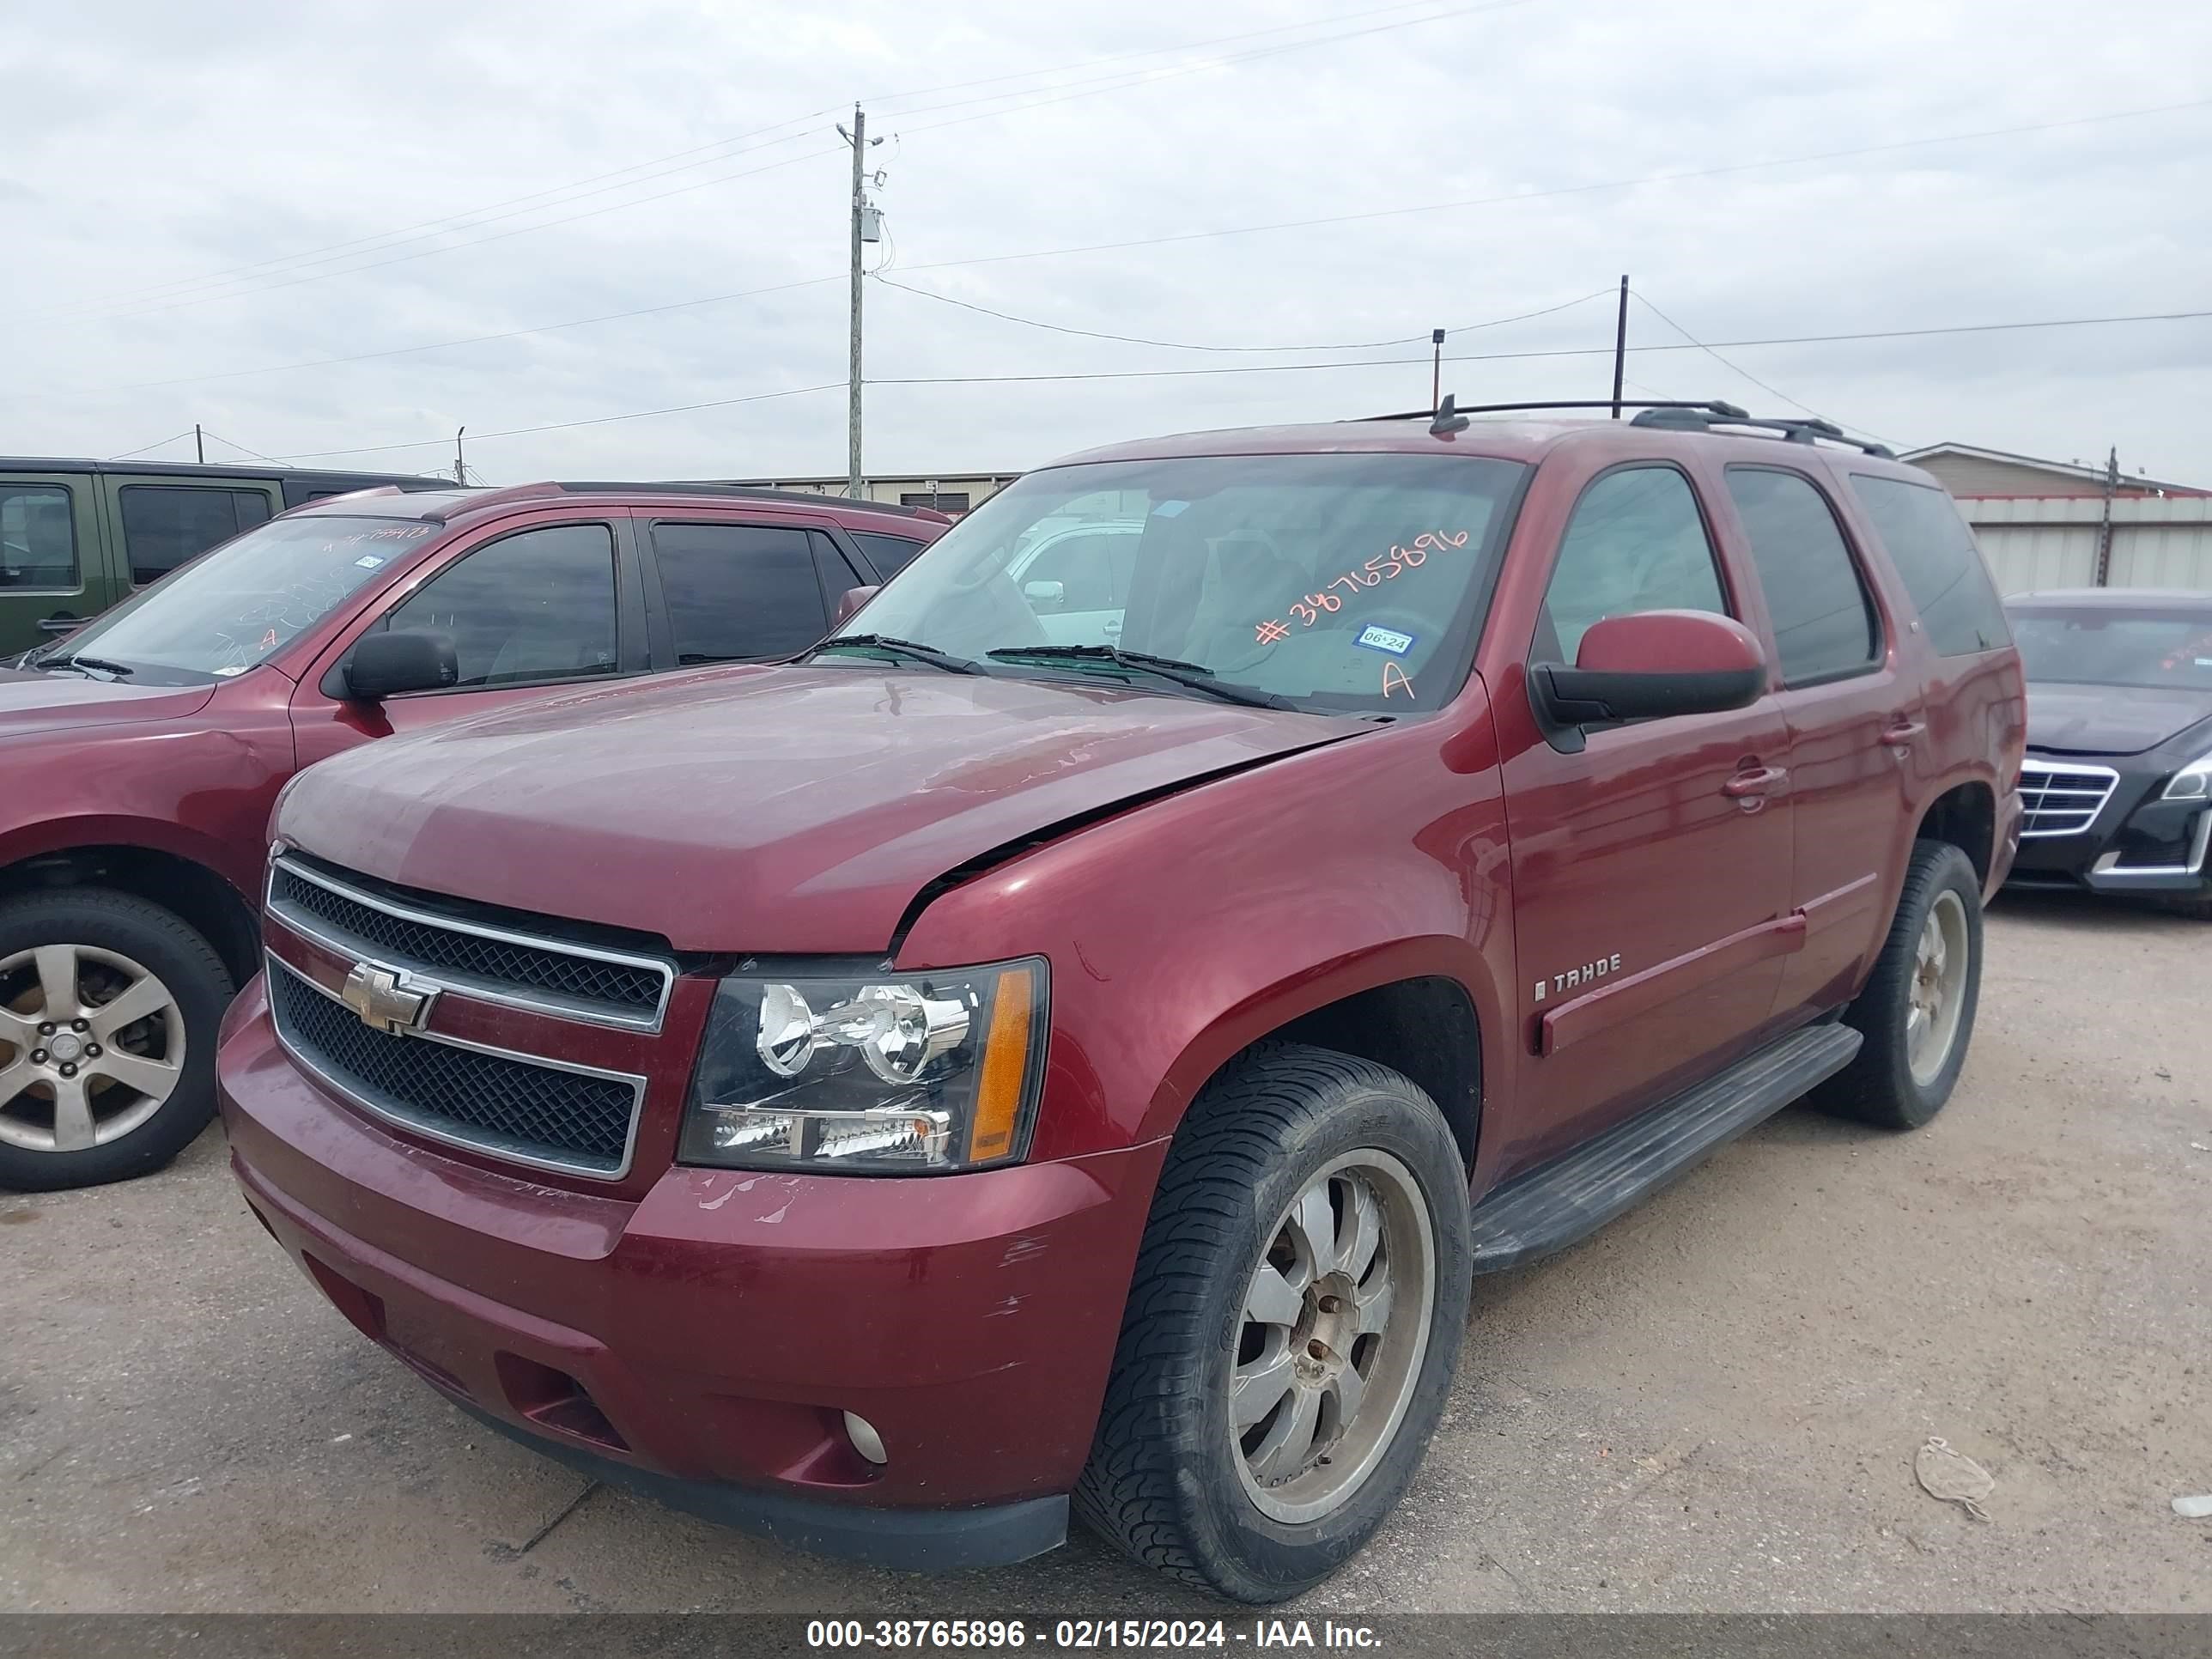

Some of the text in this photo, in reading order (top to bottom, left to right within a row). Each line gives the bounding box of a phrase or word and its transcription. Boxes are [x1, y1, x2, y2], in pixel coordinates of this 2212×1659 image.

[1255, 529, 1468, 645] #38765896
[1382, 662, 1415, 700] A
[1553, 953, 1621, 993] TAHOE
